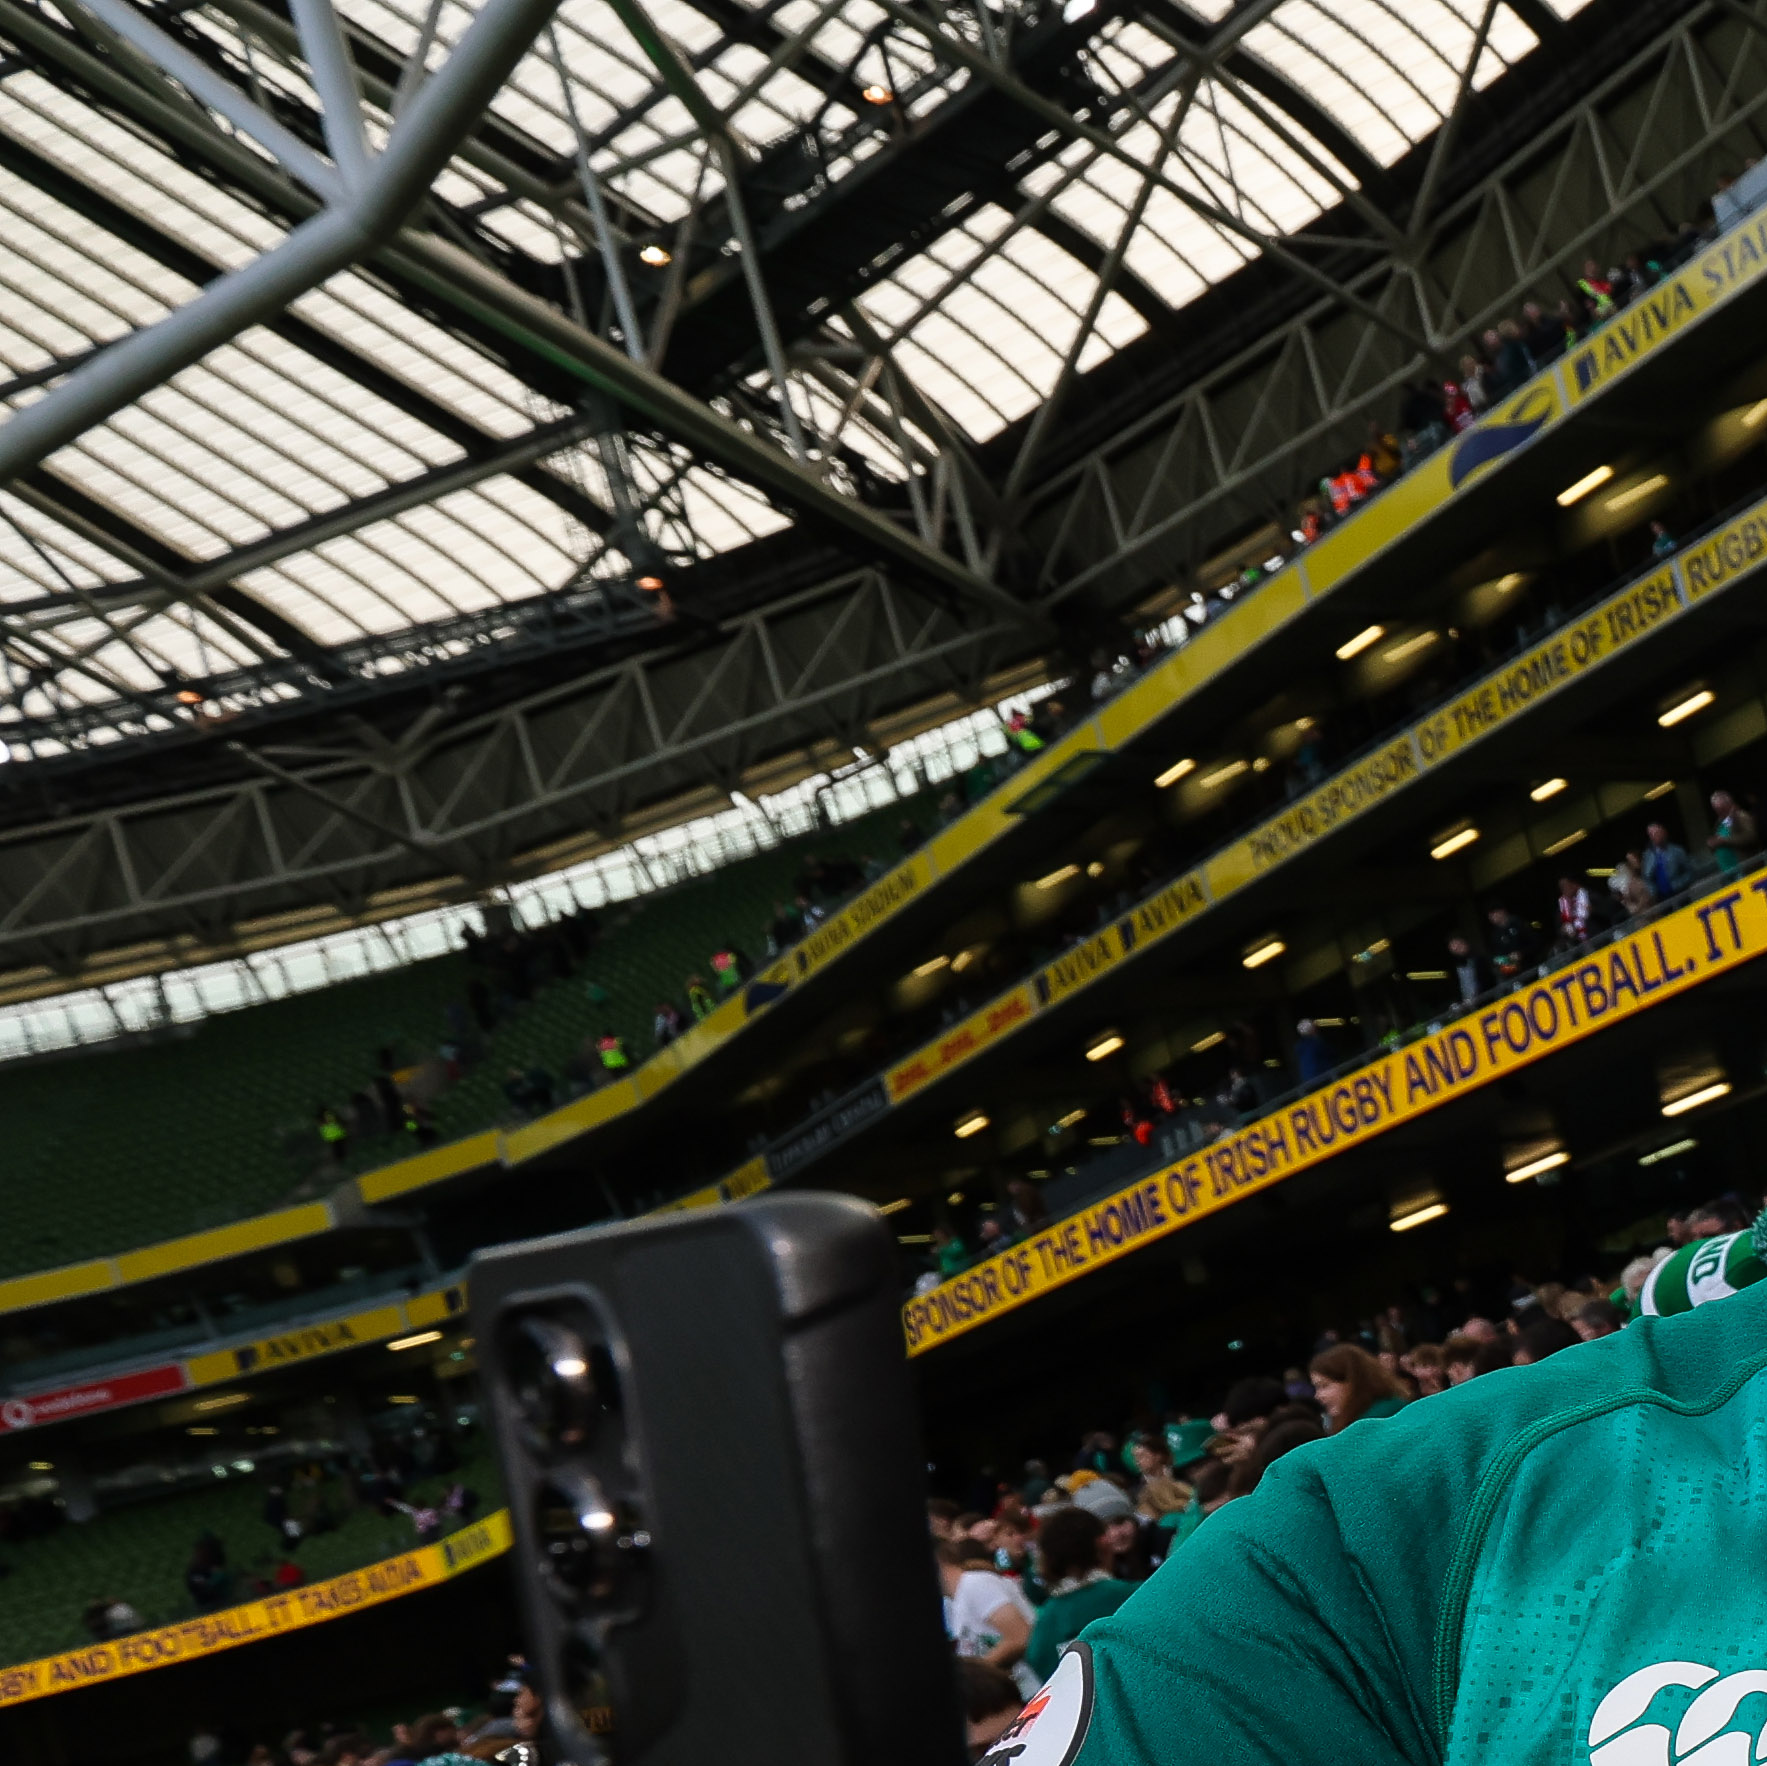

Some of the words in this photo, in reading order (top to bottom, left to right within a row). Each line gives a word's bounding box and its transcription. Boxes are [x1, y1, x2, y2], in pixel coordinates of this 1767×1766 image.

[1602, 281, 1695, 373] AVIVA
[1569, 620, 1602, 666] OF
[1605, 568, 1682, 644] IRISH
[904, 1267, 1003, 1347] SPONSOR
[1003, 1249, 1033, 1296] OF
[1035, 1223, 1086, 1279] THE
[1083, 1182, 1167, 1251] HOME
[1166, 1162, 1203, 1215] OF
[1204, 1124, 1293, 1197] IRISH
[1291, 1065, 1395, 1157] RUGBY
[1405, 1028, 1479, 1106] AND
[1479, 930, 1697, 1066] FOOTBALL.
[1696, 891, 1743, 962] IT
